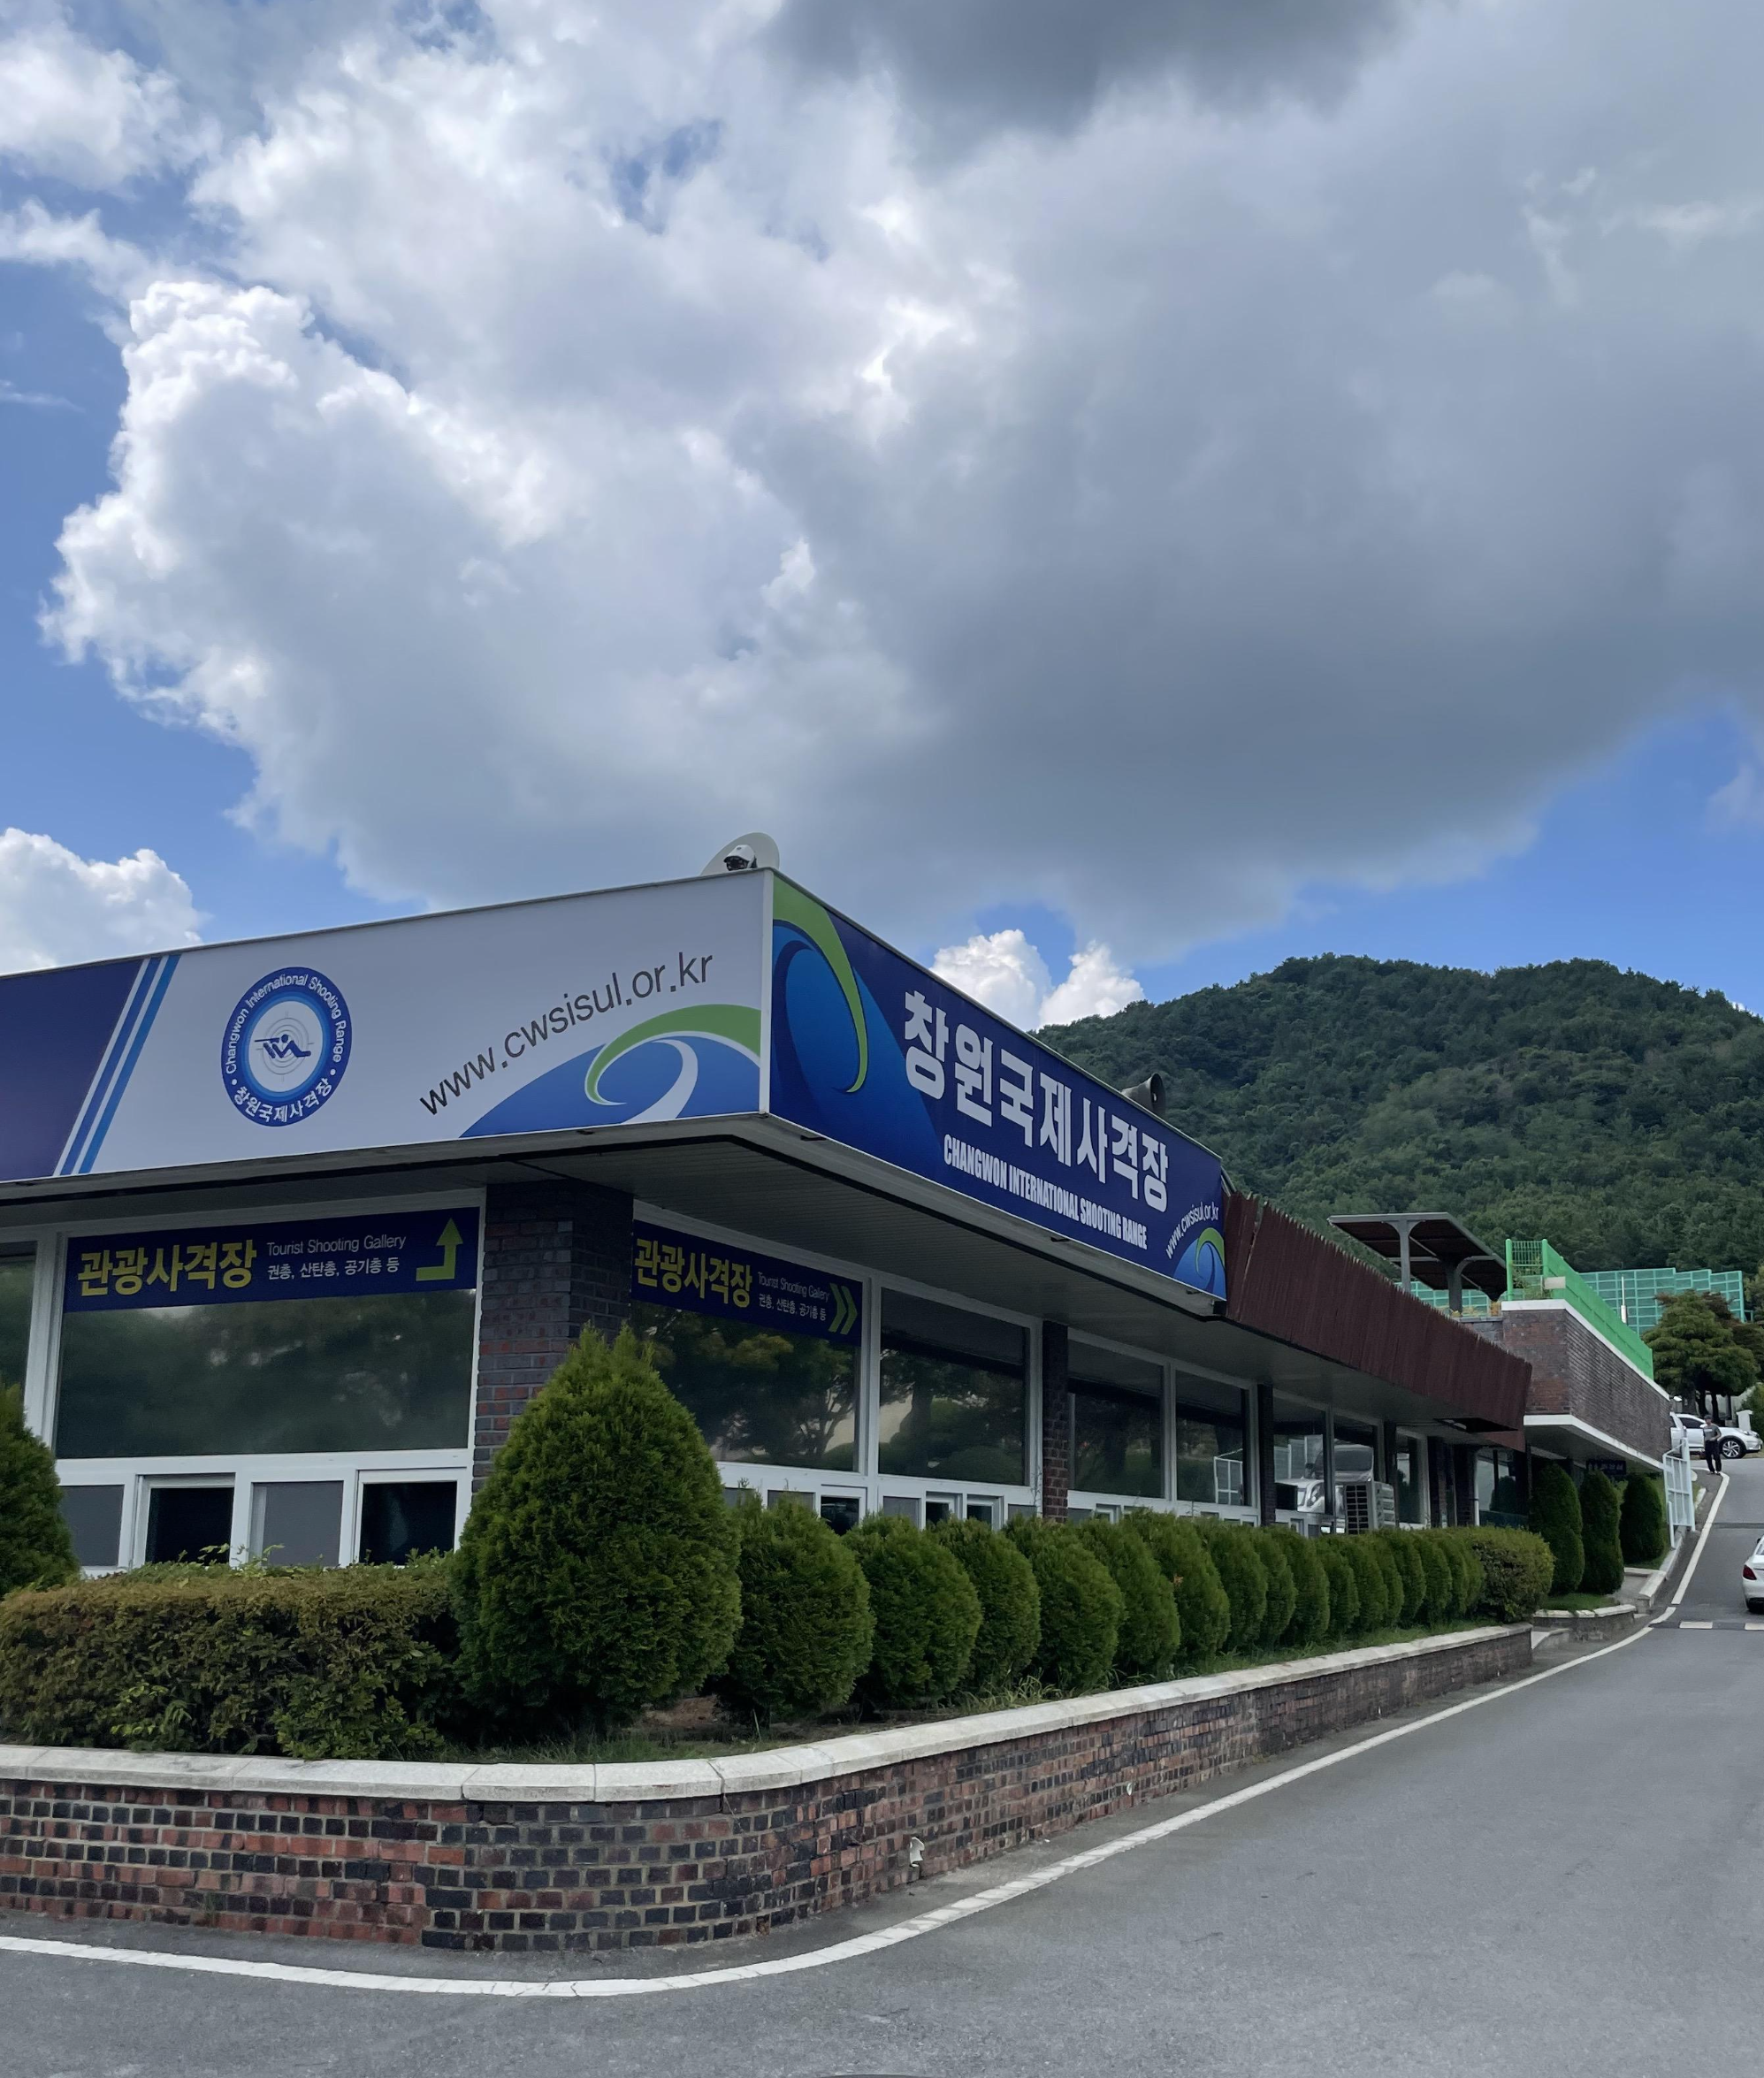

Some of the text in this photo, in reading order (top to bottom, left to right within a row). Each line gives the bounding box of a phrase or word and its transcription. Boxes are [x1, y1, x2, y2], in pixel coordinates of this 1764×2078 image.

[225, 974, 347, 1074] Changwon International Shooting Range
[419, 951, 713, 1115] www.cwsisul.or.kr
[234, 1078, 332, 1123] 창원국제사격장
[905, 990, 1169, 1212] 창원국제사격장
[943, 1134, 1148, 1250] CHANGWON INTERNATIONAL SHOOTING RANGE
[266, 1234, 407, 1257] Tourist Shooting Gallery
[1165, 1201, 1219, 1259] www.cwsisul.or.kr
[77, 1239, 256, 1297] 관광사격장
[267, 1257, 401, 1280] 권총, 산탄총, 공기총 등
[634, 1238, 752, 1309] 관광사격장
[757, 1271, 830, 1303] Tourist Shooting Gallery
[819, 1307, 827, 1322] 등
